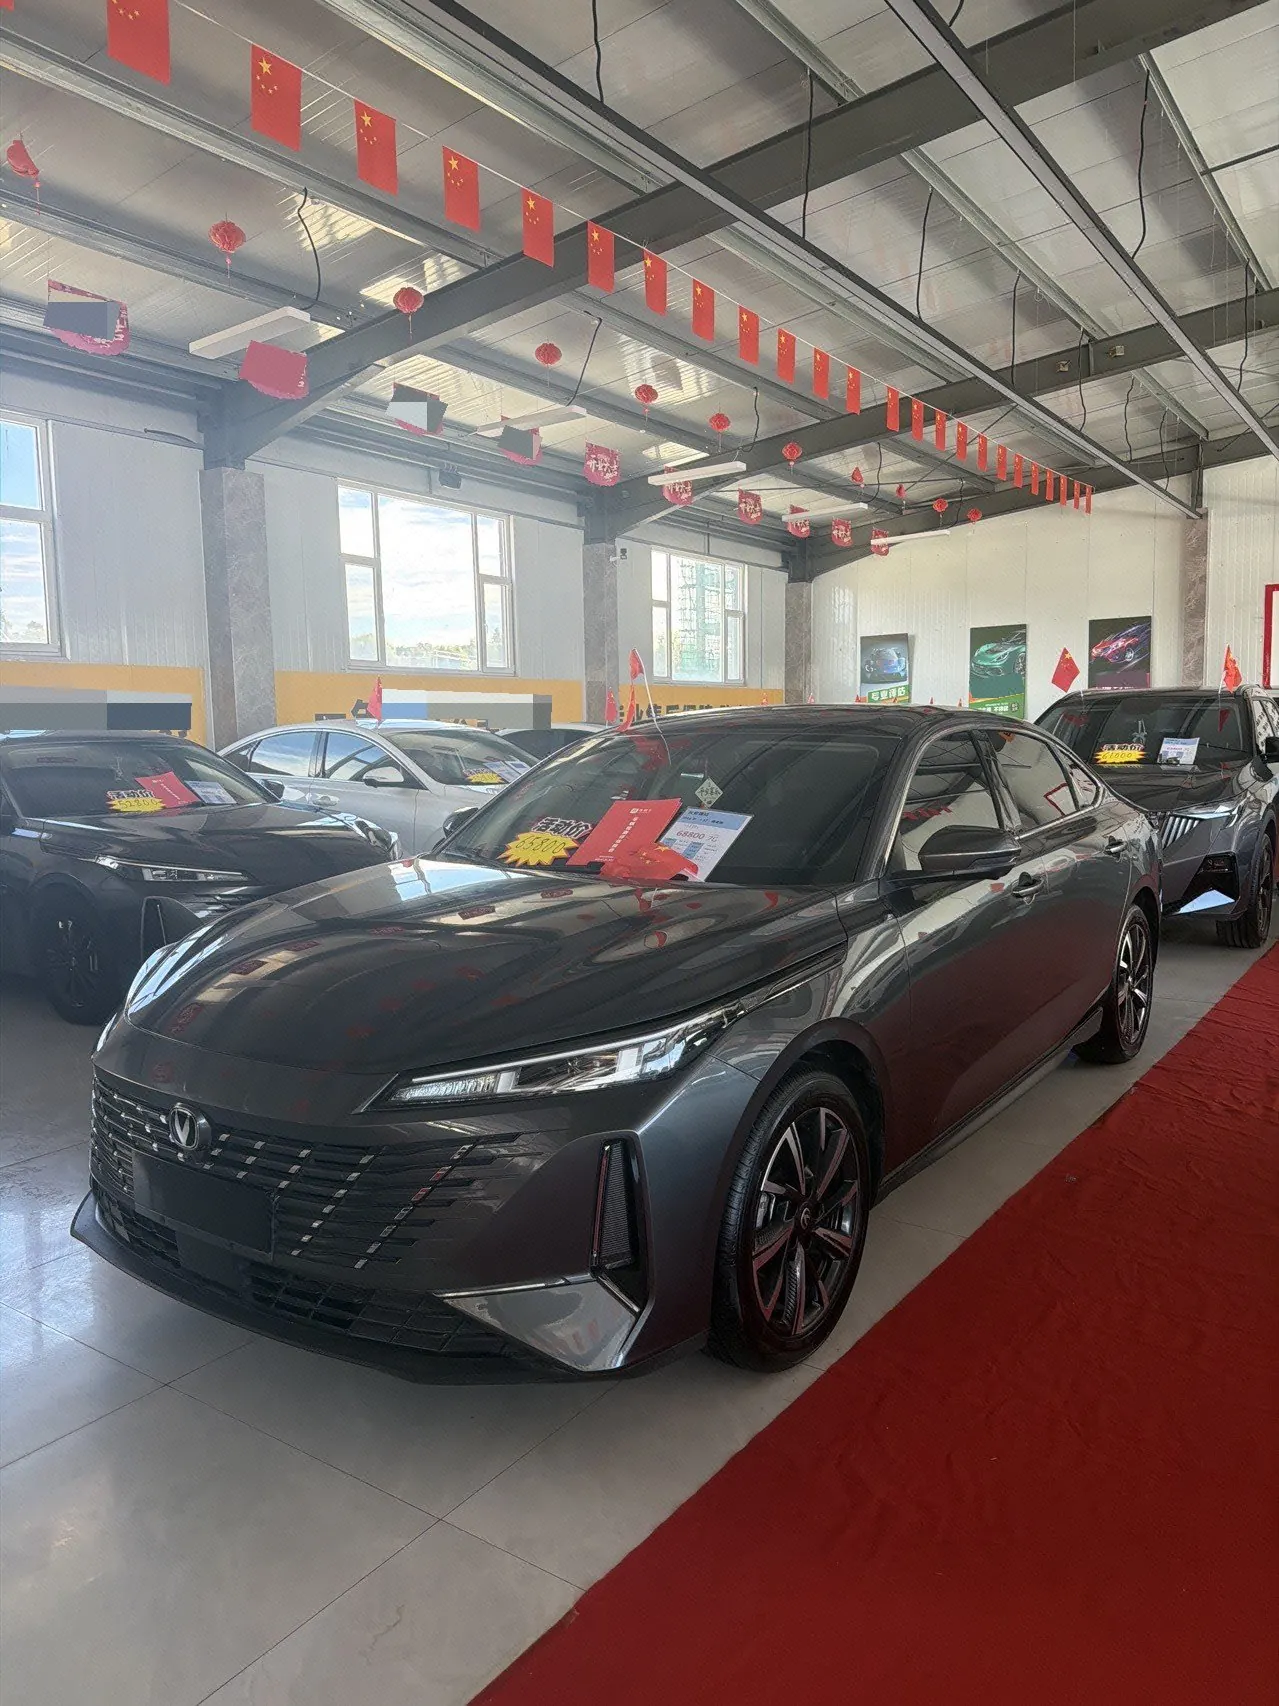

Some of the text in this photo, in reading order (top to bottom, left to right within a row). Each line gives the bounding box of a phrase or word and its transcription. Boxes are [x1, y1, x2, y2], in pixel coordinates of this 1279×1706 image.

[871, 686, 906, 701] 专业评估
[532, 817, 591, 838] 活动价
[676, 830, 706, 840] 68800
[515, 835, 567, 854] 65800
